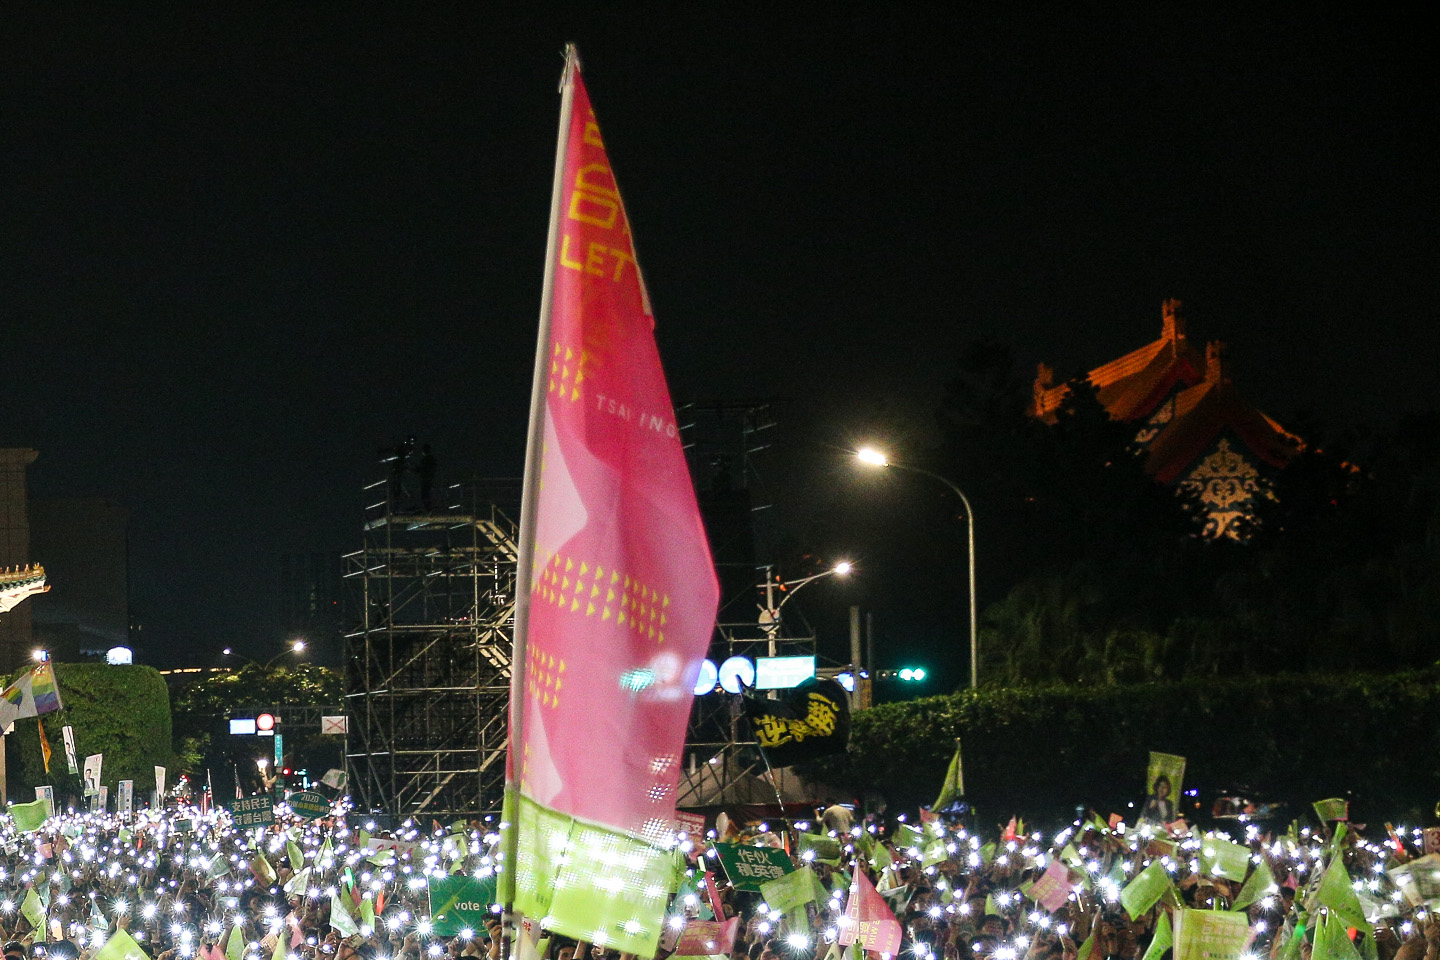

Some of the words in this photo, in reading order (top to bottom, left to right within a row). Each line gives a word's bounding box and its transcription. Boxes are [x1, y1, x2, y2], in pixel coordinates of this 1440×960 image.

[560, 234, 634, 283] LET
[595, 393, 632, 422] TSAI
[301, 794, 321, 803] 2020
[454, 901, 480, 911] vote
